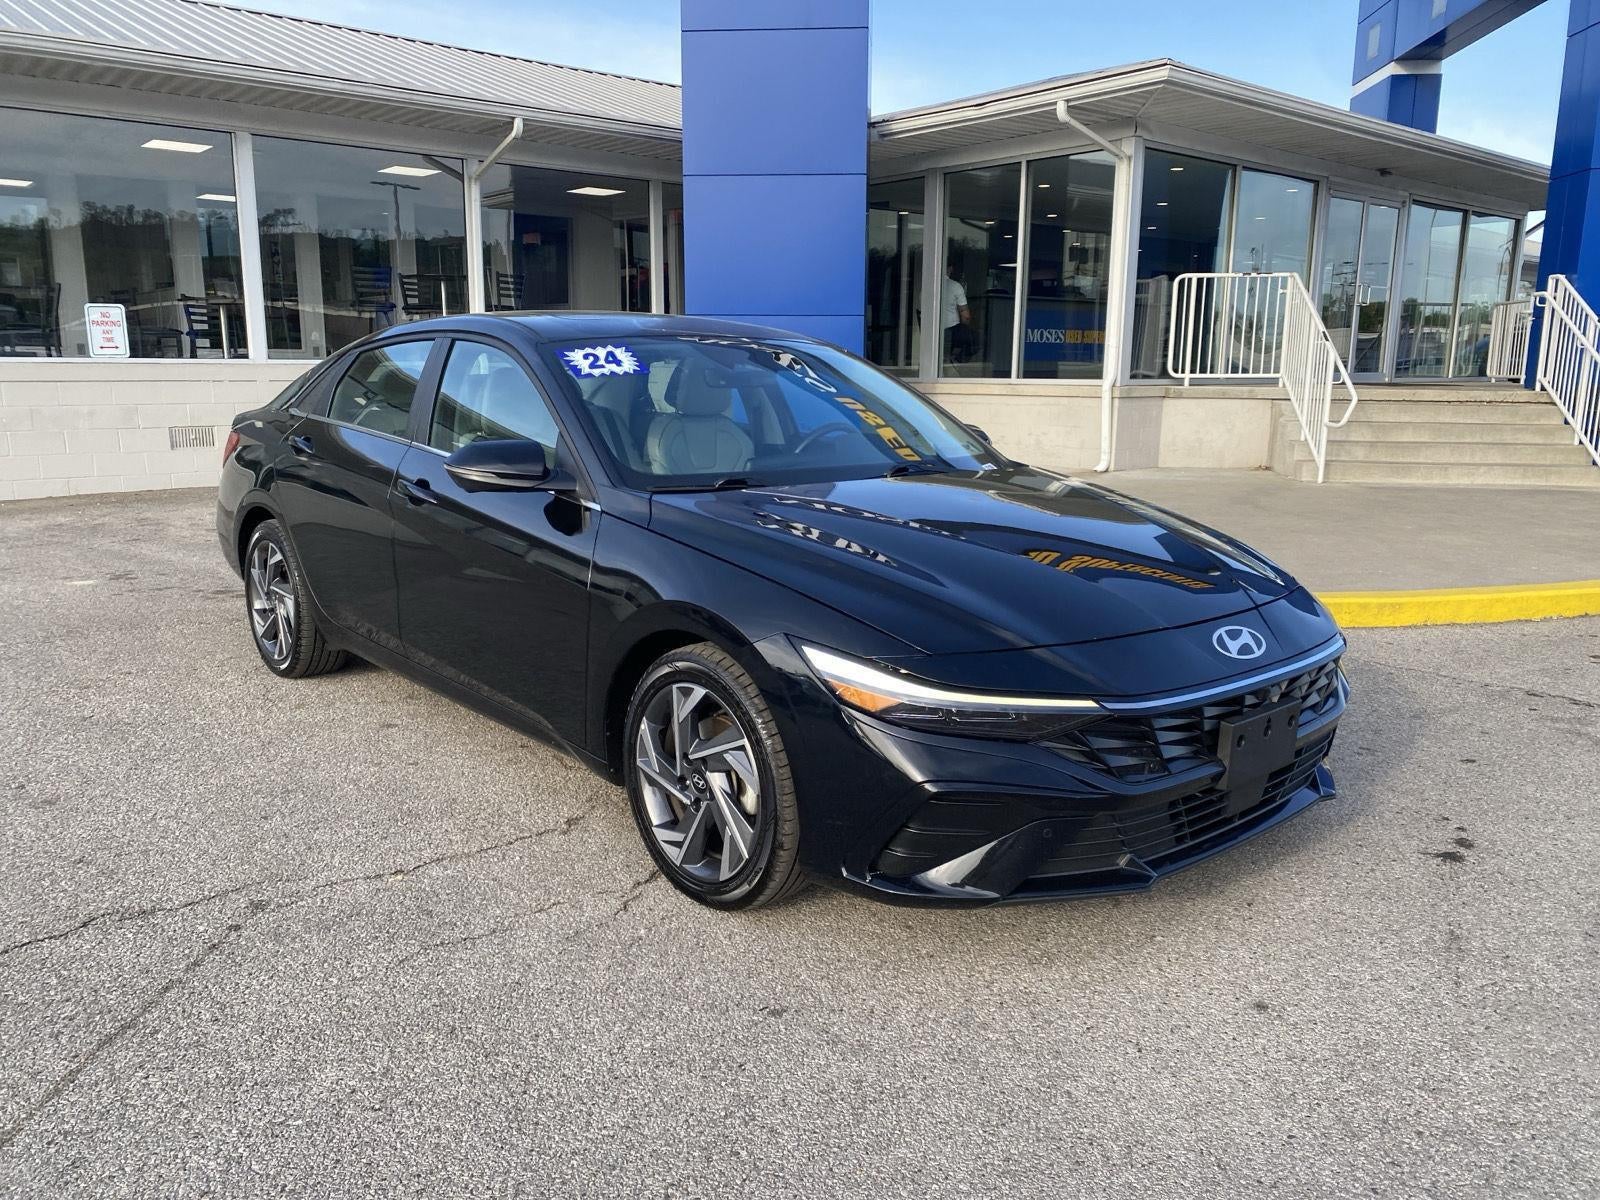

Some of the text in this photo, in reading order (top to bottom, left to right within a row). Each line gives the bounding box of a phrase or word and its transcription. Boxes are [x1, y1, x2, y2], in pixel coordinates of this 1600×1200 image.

[100, 311, 111, 319] NO
[91, 320, 121, 328] PARKING
[1025, 328, 1066, 344] MOSES
[582, 350, 623, 370] 24
